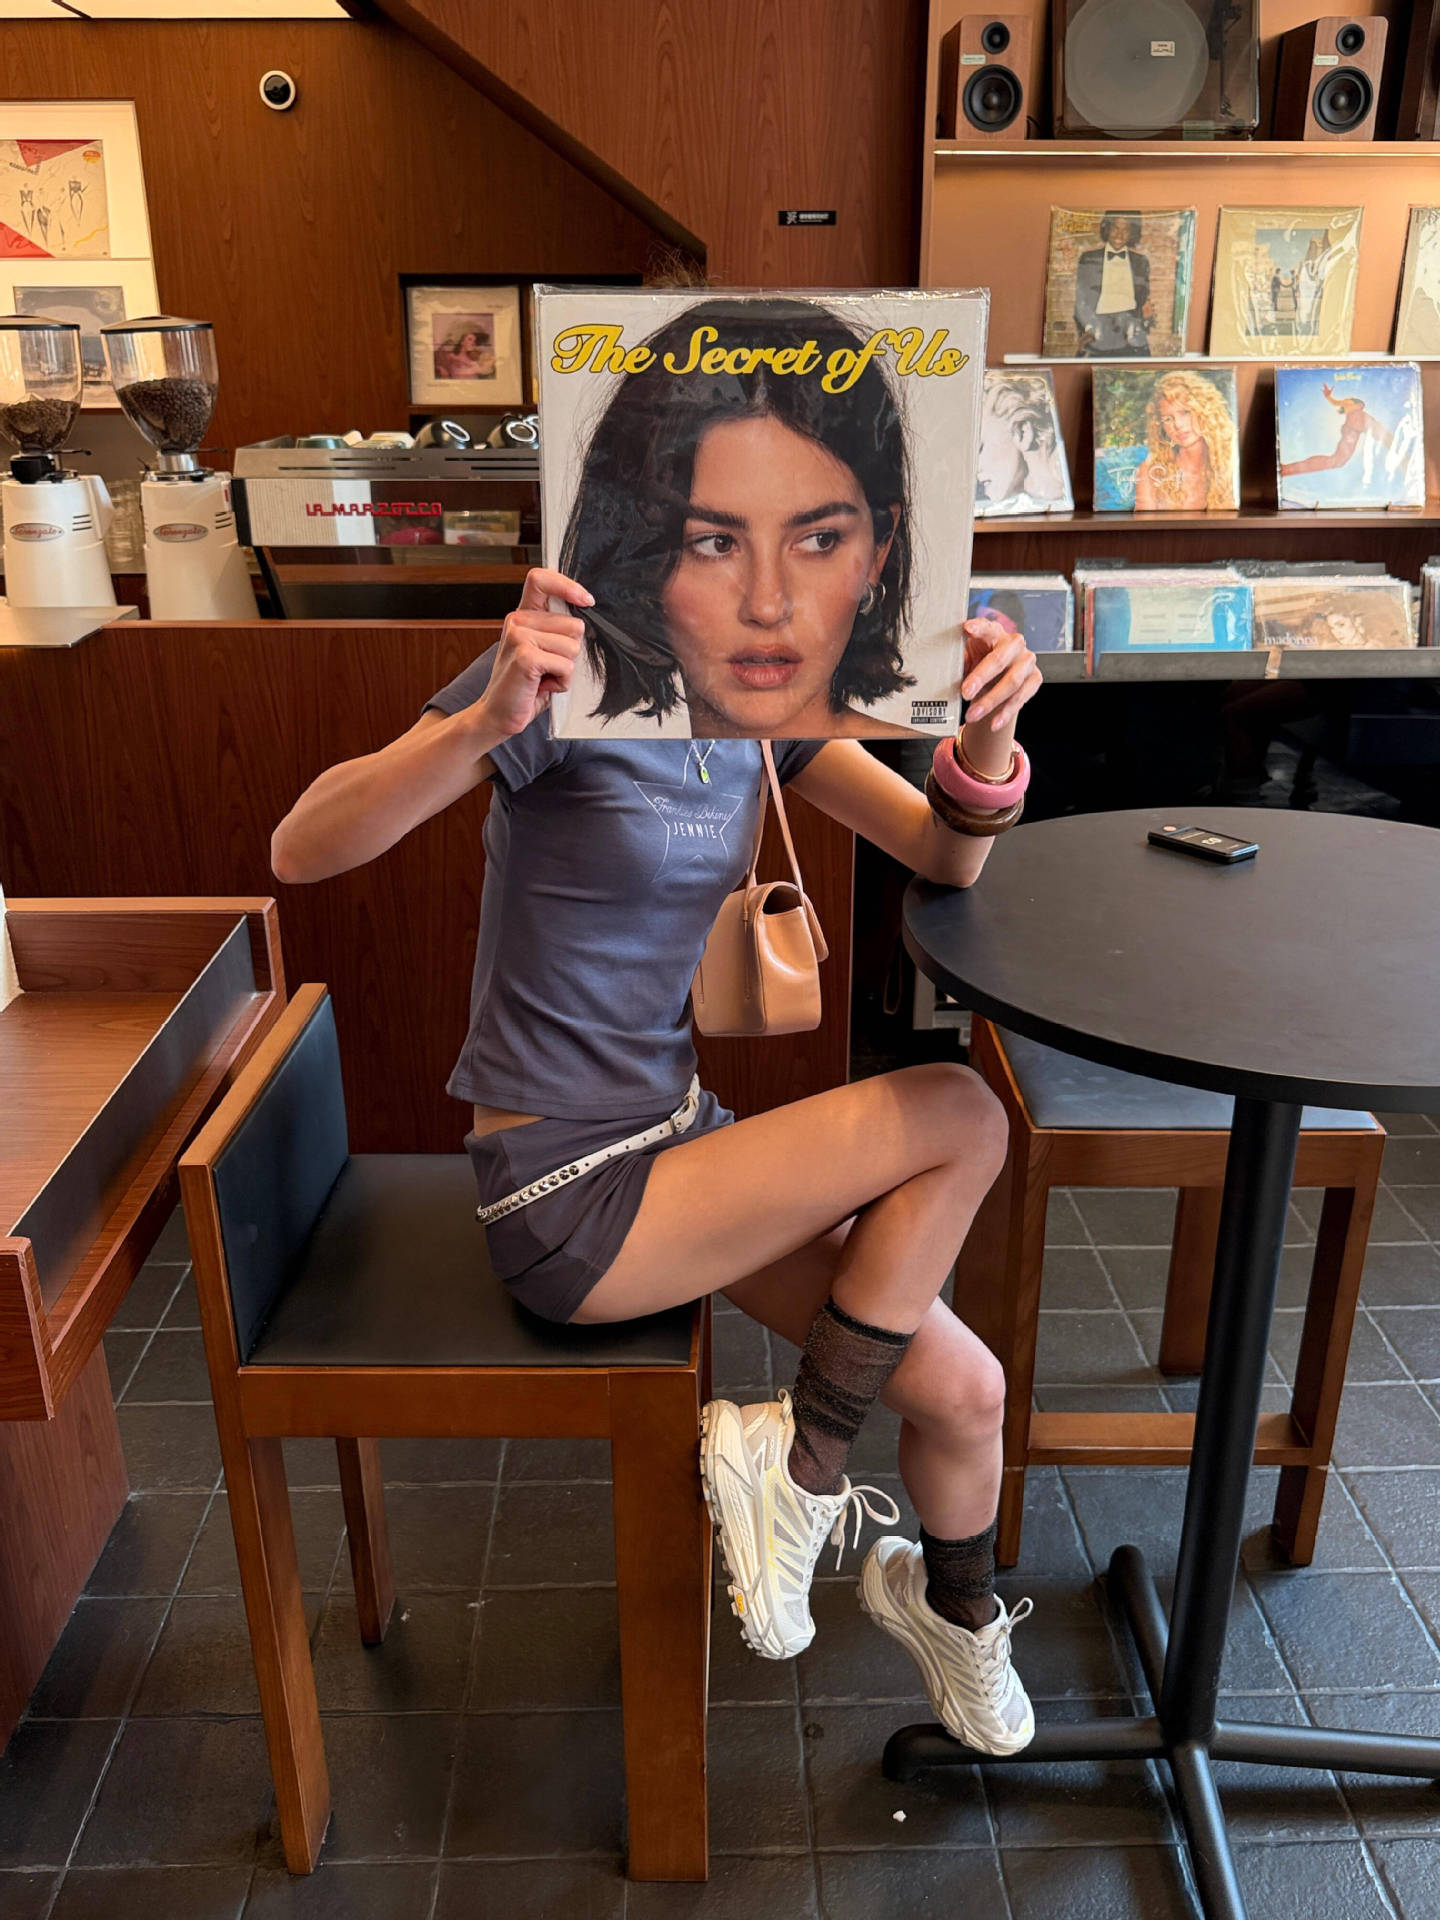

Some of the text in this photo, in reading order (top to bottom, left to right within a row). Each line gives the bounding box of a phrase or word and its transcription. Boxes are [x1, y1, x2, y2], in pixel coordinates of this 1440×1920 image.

[551, 323, 970, 394] The Secret of Us
[332, 502, 442, 516] MARZOCCO
[1264, 631, 1319, 646] madonna
[912, 708, 946, 716] ADVISORY
[673, 821, 718, 839] JENNIE
